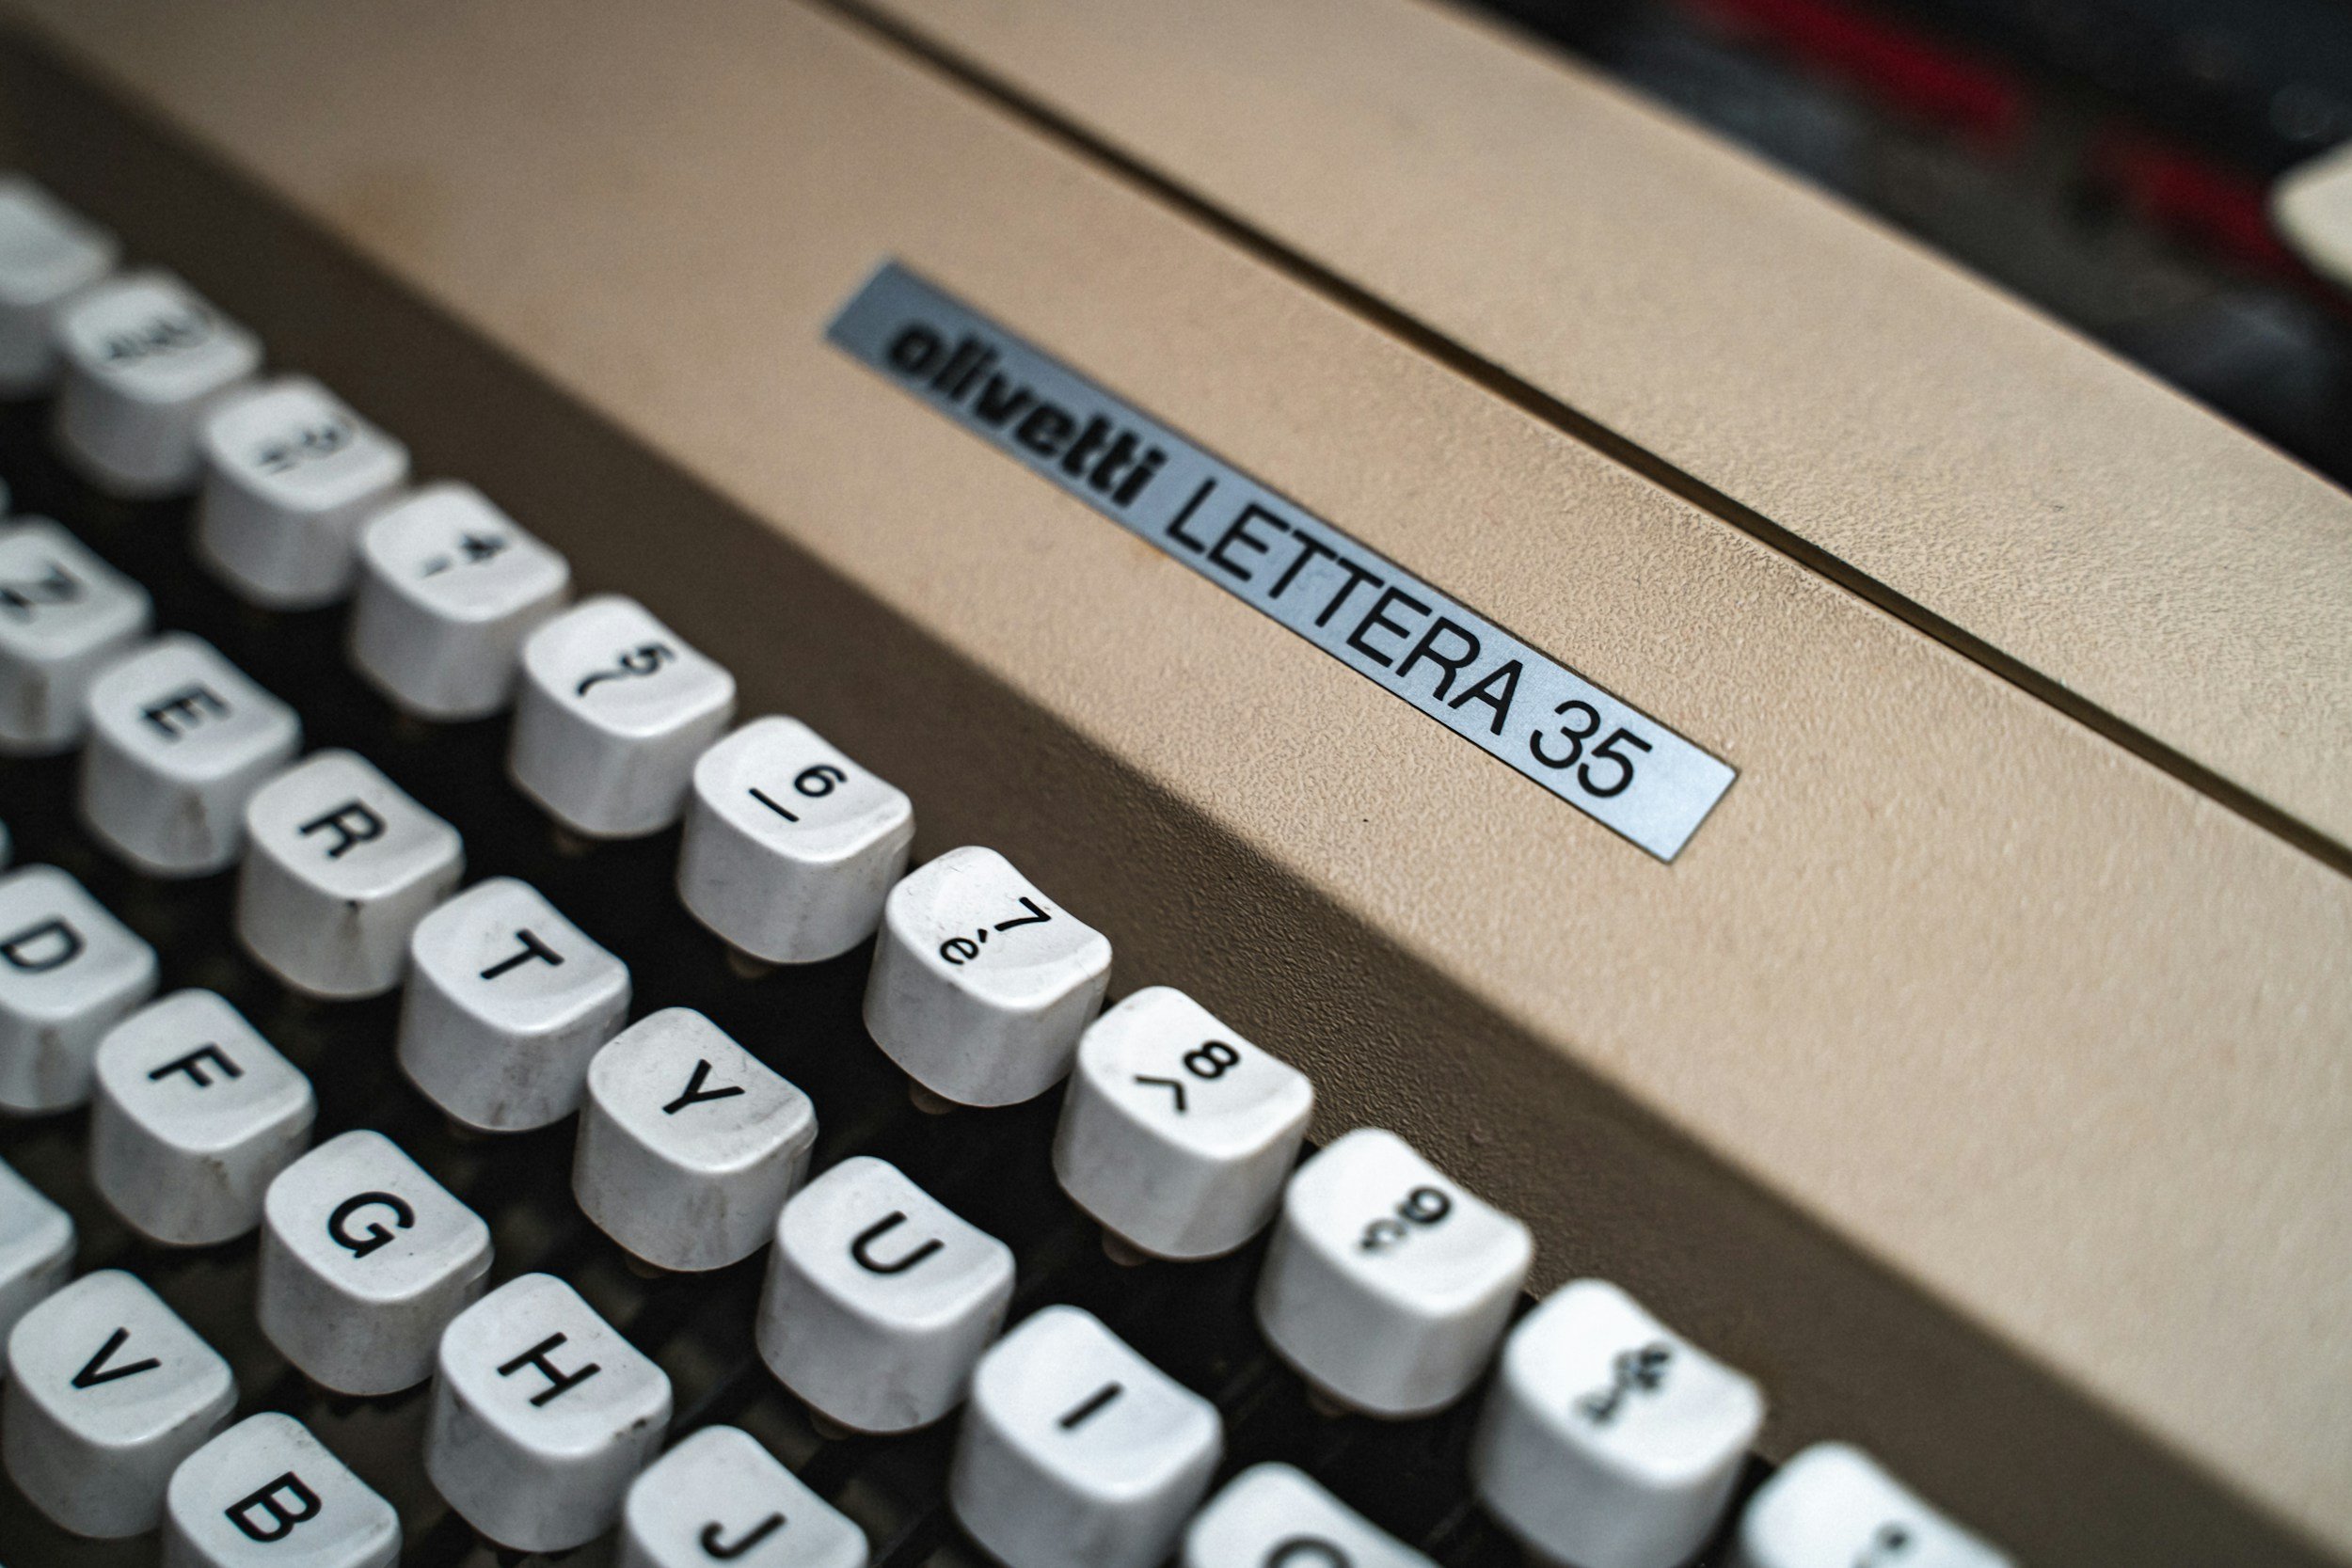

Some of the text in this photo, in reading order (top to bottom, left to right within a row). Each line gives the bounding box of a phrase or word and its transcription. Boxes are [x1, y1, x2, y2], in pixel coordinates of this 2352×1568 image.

[886, 322, 1653, 799] olivetti LETTERA 35
[618, 641, 676, 676] 5
[138, 683, 233, 741] E
[794, 765, 848, 798] 6
[298, 800, 387, 860] R
[994, 896, 1052, 932] 7
[0, 916, 87, 973] D
[480, 929, 565, 980] T
[939, 928, 989, 965] è
[148, 1044, 245, 1087] F
[663, 1059, 746, 1115] Y
[1182, 1040, 1240, 1080] 8
[328, 1191, 415, 1259] G
[1396, 1184, 1453, 1224] 9
[850, 1210, 944, 1274] U
[71, 1326, 162, 1389] V
[497, 1332, 602, 1407] H
[1056, 1381, 1125, 1433] I
[224, 1471, 323, 1543] B
[700, 1511, 787, 1561] J
